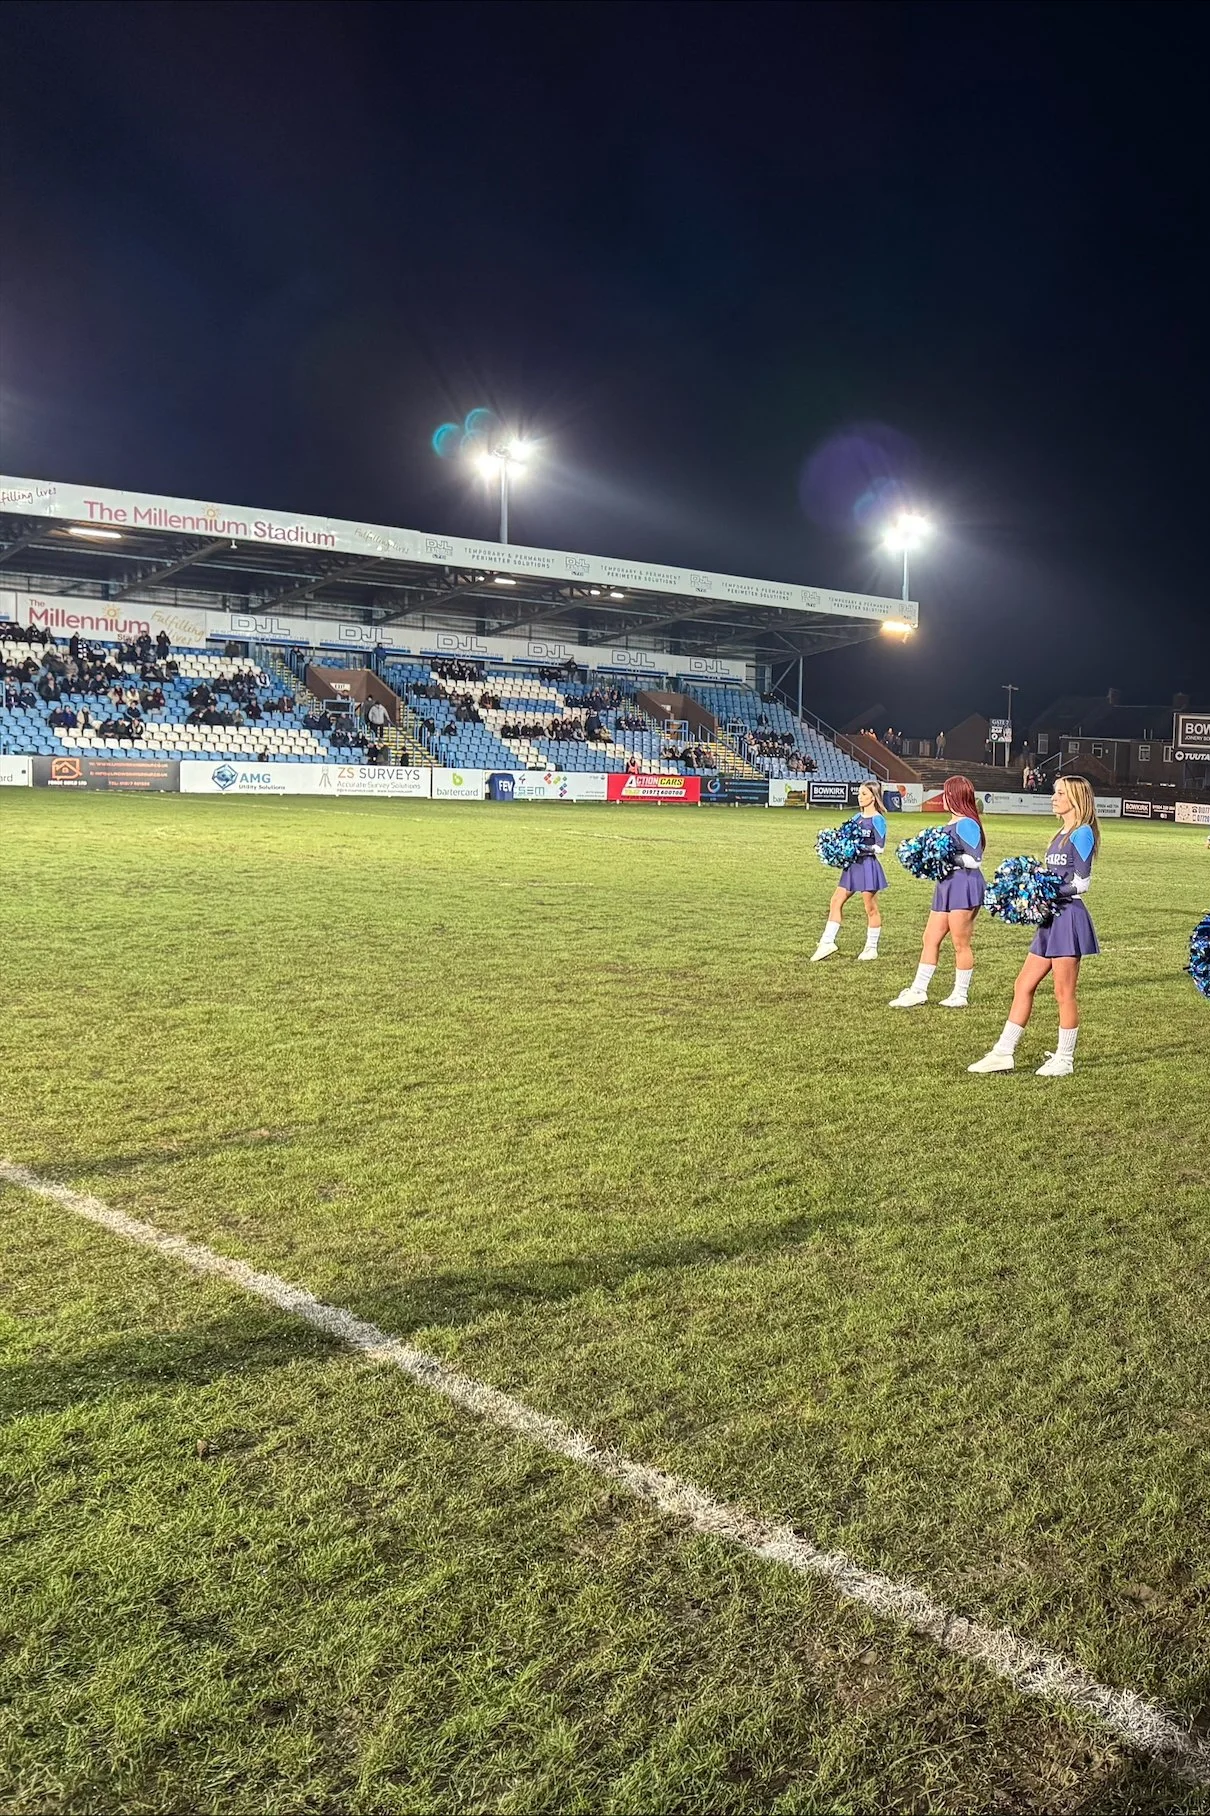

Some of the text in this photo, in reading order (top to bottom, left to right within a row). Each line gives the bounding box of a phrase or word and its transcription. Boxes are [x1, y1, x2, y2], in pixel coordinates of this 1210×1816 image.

[36, 487, 57, 497] lives
[83, 500, 335, 546] The Millennium Stadium
[465, 547, 505, 559] TEMPORARY
[515, 554, 555, 564] PERMANENT
[472, 555, 551, 569] PERIMETER SOLUTIONS
[601, 564, 636, 575] TEMPORARY
[607, 571, 677, 585] PERIMETER SOLUTIONS
[29, 599, 46, 608] The
[30, 607, 150, 634] Millennium
[231, 615, 290, 636] DJL
[339, 624, 393, 644] DJL
[438, 633, 487, 653] DJL
[528, 642, 574, 661] DJL
[612, 650, 655, 668] DJL
[690, 658, 730, 675] DJL
[240, 773, 271, 783] AMG
[338, 767, 420, 780] ZS SURVEYS
[337, 780, 367, 788] Accurate
[499, 780, 514, 792] FEV
[625, 774, 684, 788] ACTION CARS
[437, 787, 478, 797] bartercard
[813, 787, 845, 796] BOWKIRK
